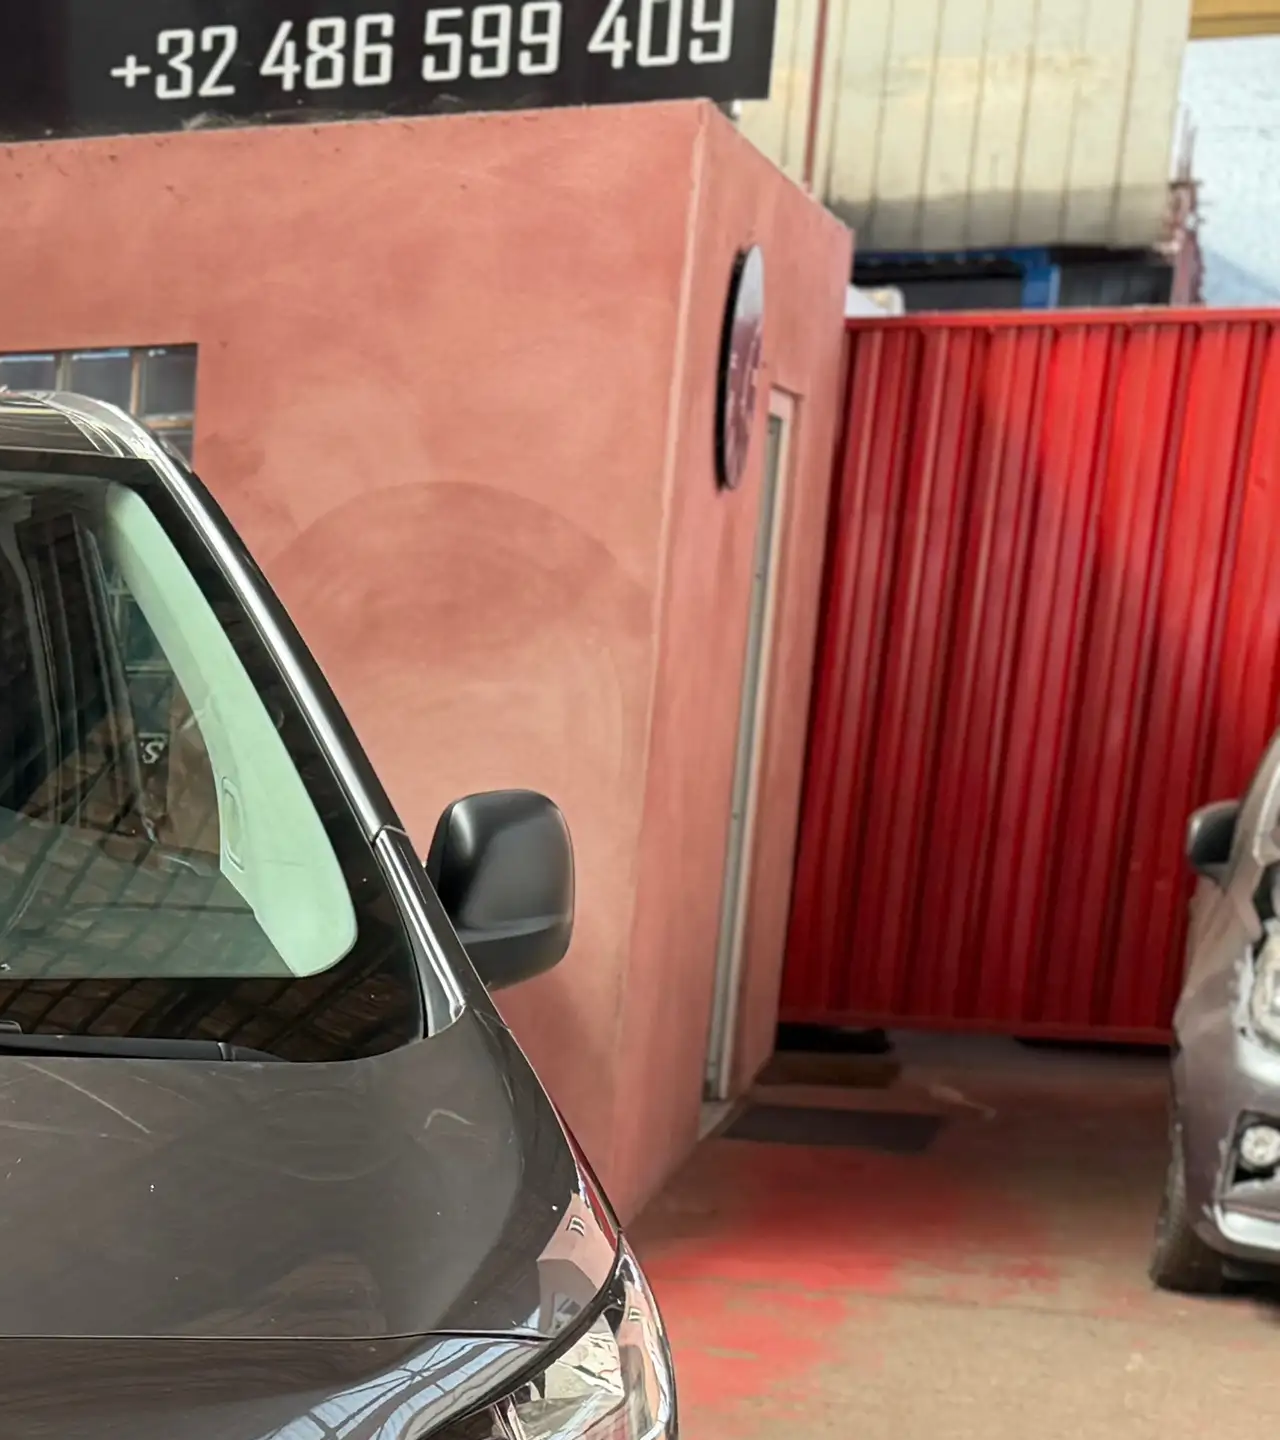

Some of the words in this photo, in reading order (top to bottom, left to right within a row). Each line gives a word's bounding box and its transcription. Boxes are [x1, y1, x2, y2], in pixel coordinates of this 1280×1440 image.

[111, 26, 238, 99] +32
[260, 14, 395, 90] 486
[422, 0, 562, 81] 599
[587, 0, 735, 69] 409
